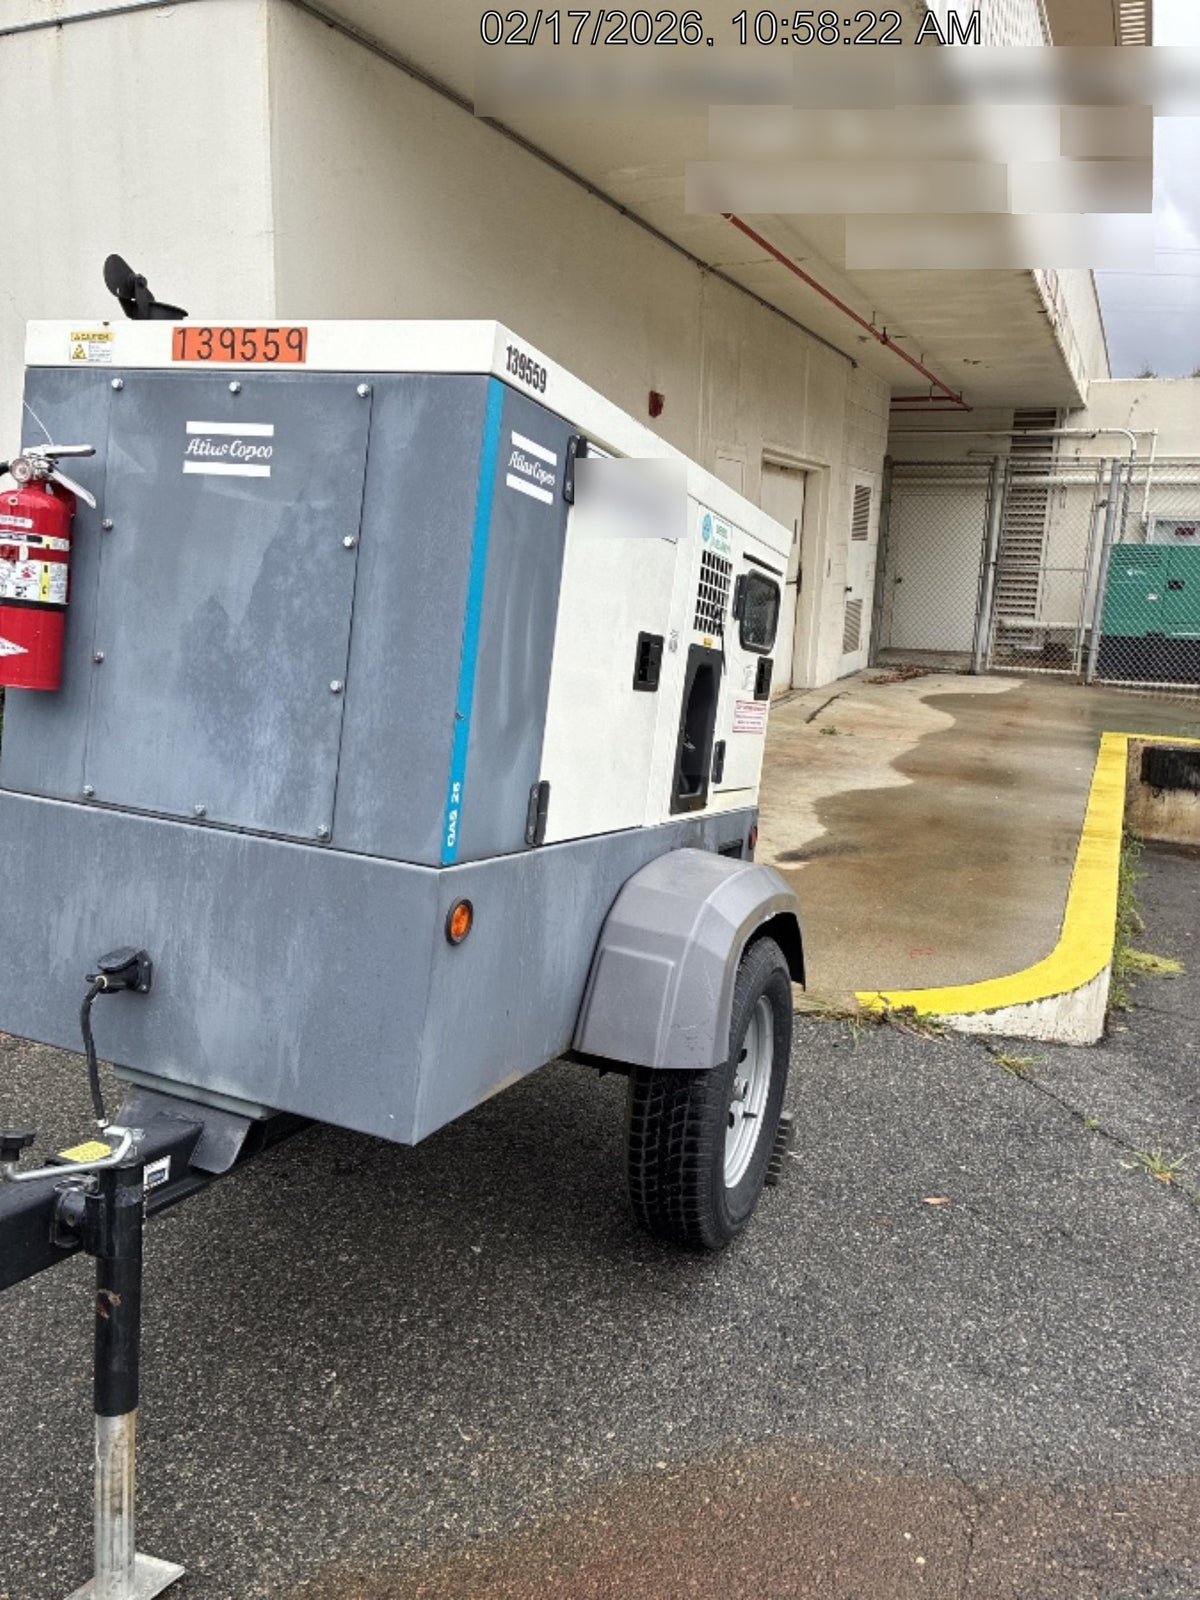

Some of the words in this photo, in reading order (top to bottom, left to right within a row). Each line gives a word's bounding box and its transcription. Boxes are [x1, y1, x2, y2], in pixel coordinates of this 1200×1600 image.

[176, 327, 303, 361] 139559
[506, 345, 546, 393] 139559
[185, 438, 229, 456] Atlas
[230, 439, 273, 462] Copco
